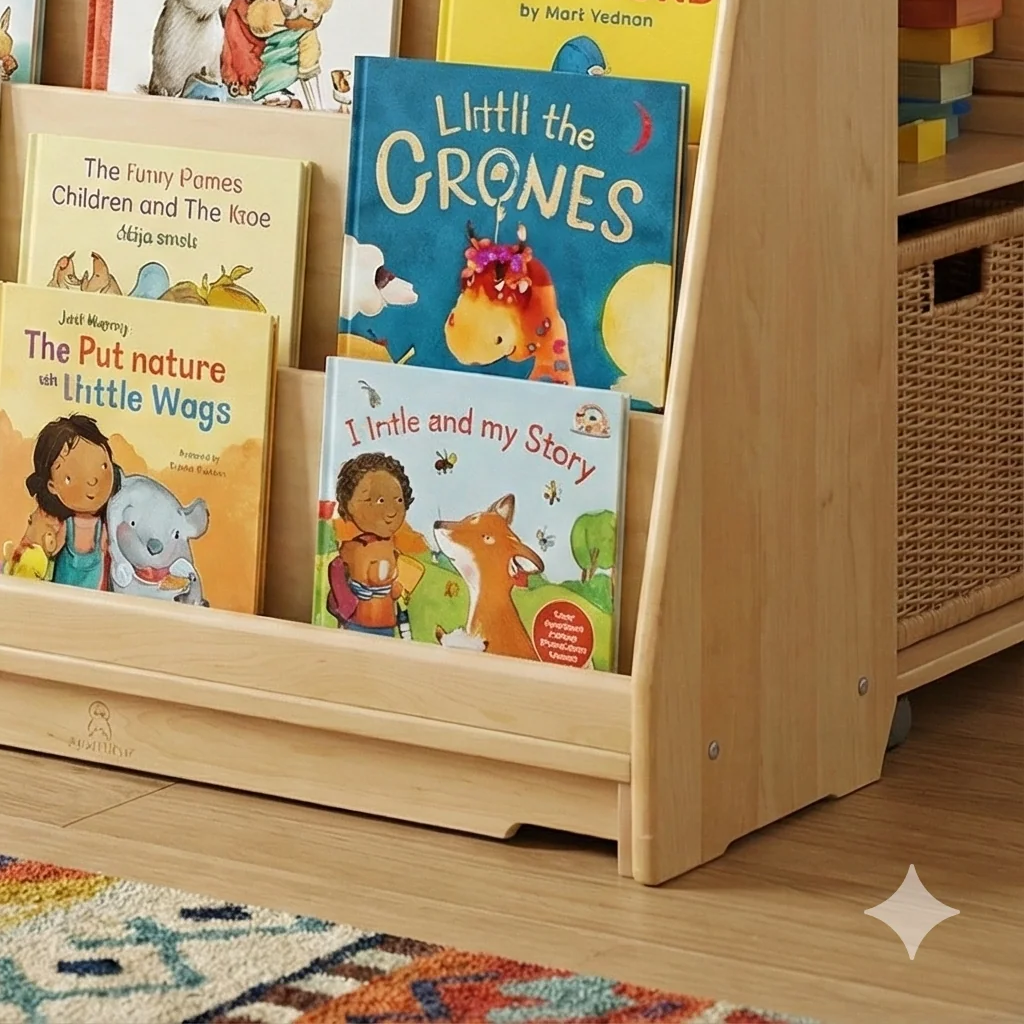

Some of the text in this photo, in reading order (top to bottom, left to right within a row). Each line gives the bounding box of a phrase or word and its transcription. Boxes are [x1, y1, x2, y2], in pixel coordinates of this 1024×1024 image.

[519, 3, 540, 22] by
[542, 103, 595, 151] the
[84, 157, 120, 181] The
[52, 185, 132, 213] Children
[140, 196, 178, 218] and
[184, 198, 221, 223] The
[24, 329, 226, 383] The Put nature
[152, 384, 231, 432] Wags
[345, 418, 361, 447] I
[428, 407, 474, 435] and
[480, 418, 518, 453] my
[525, 423, 596, 485] Story
